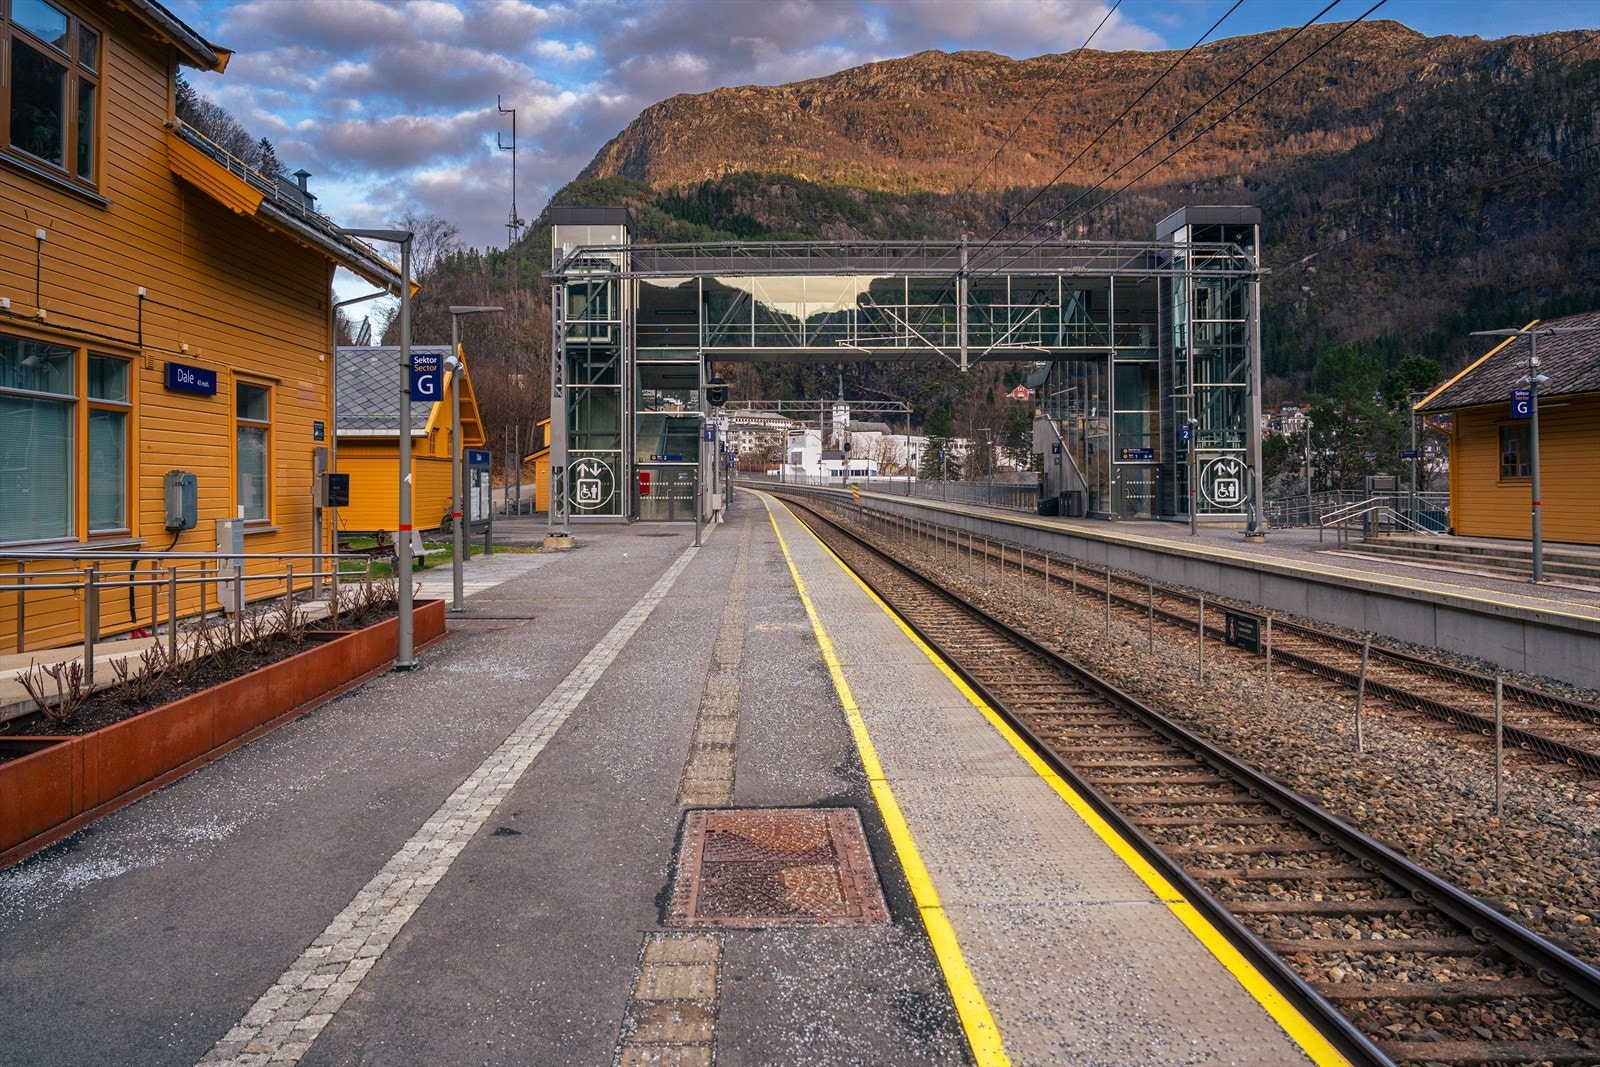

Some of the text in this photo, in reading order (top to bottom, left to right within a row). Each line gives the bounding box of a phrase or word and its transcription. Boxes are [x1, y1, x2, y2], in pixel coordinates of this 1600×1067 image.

[414, 356, 437, 364] Sektor
[177, 368, 194, 384] Dale
[418, 374, 434, 394] G
[1518, 402, 1528, 414] G
[708, 432, 712, 440] 1
[1184, 430, 1188, 438] 2
